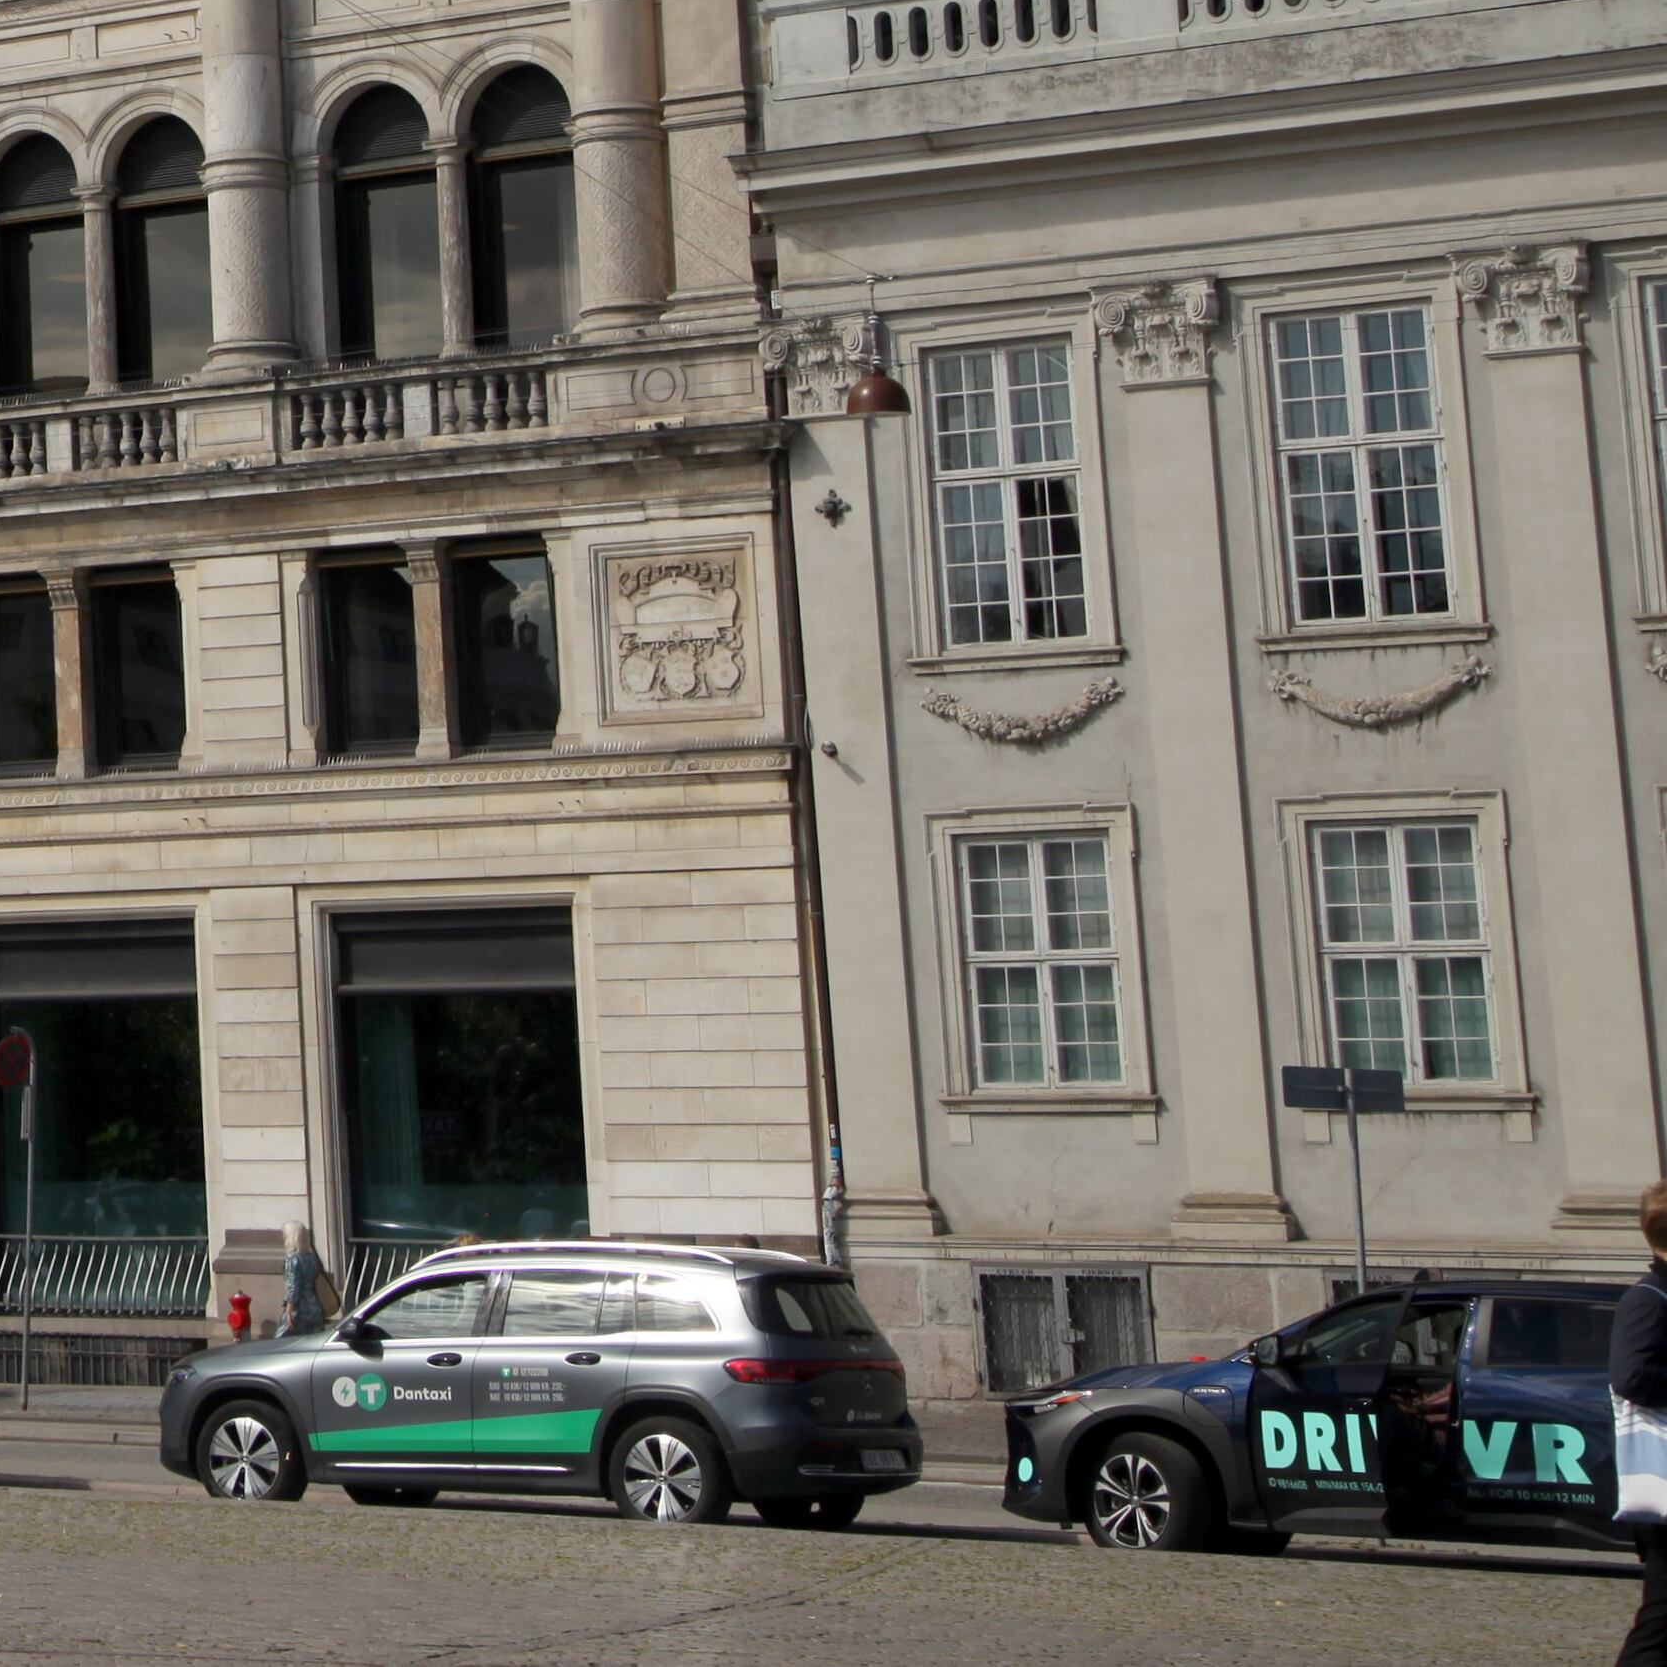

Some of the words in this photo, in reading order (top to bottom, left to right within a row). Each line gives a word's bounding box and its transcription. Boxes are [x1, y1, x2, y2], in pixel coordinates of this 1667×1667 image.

[393, 1386, 452, 1402] Dantaxi
[1517, 1490, 1530, 1500] 10
[1571, 1493, 1595, 1504] MIN
